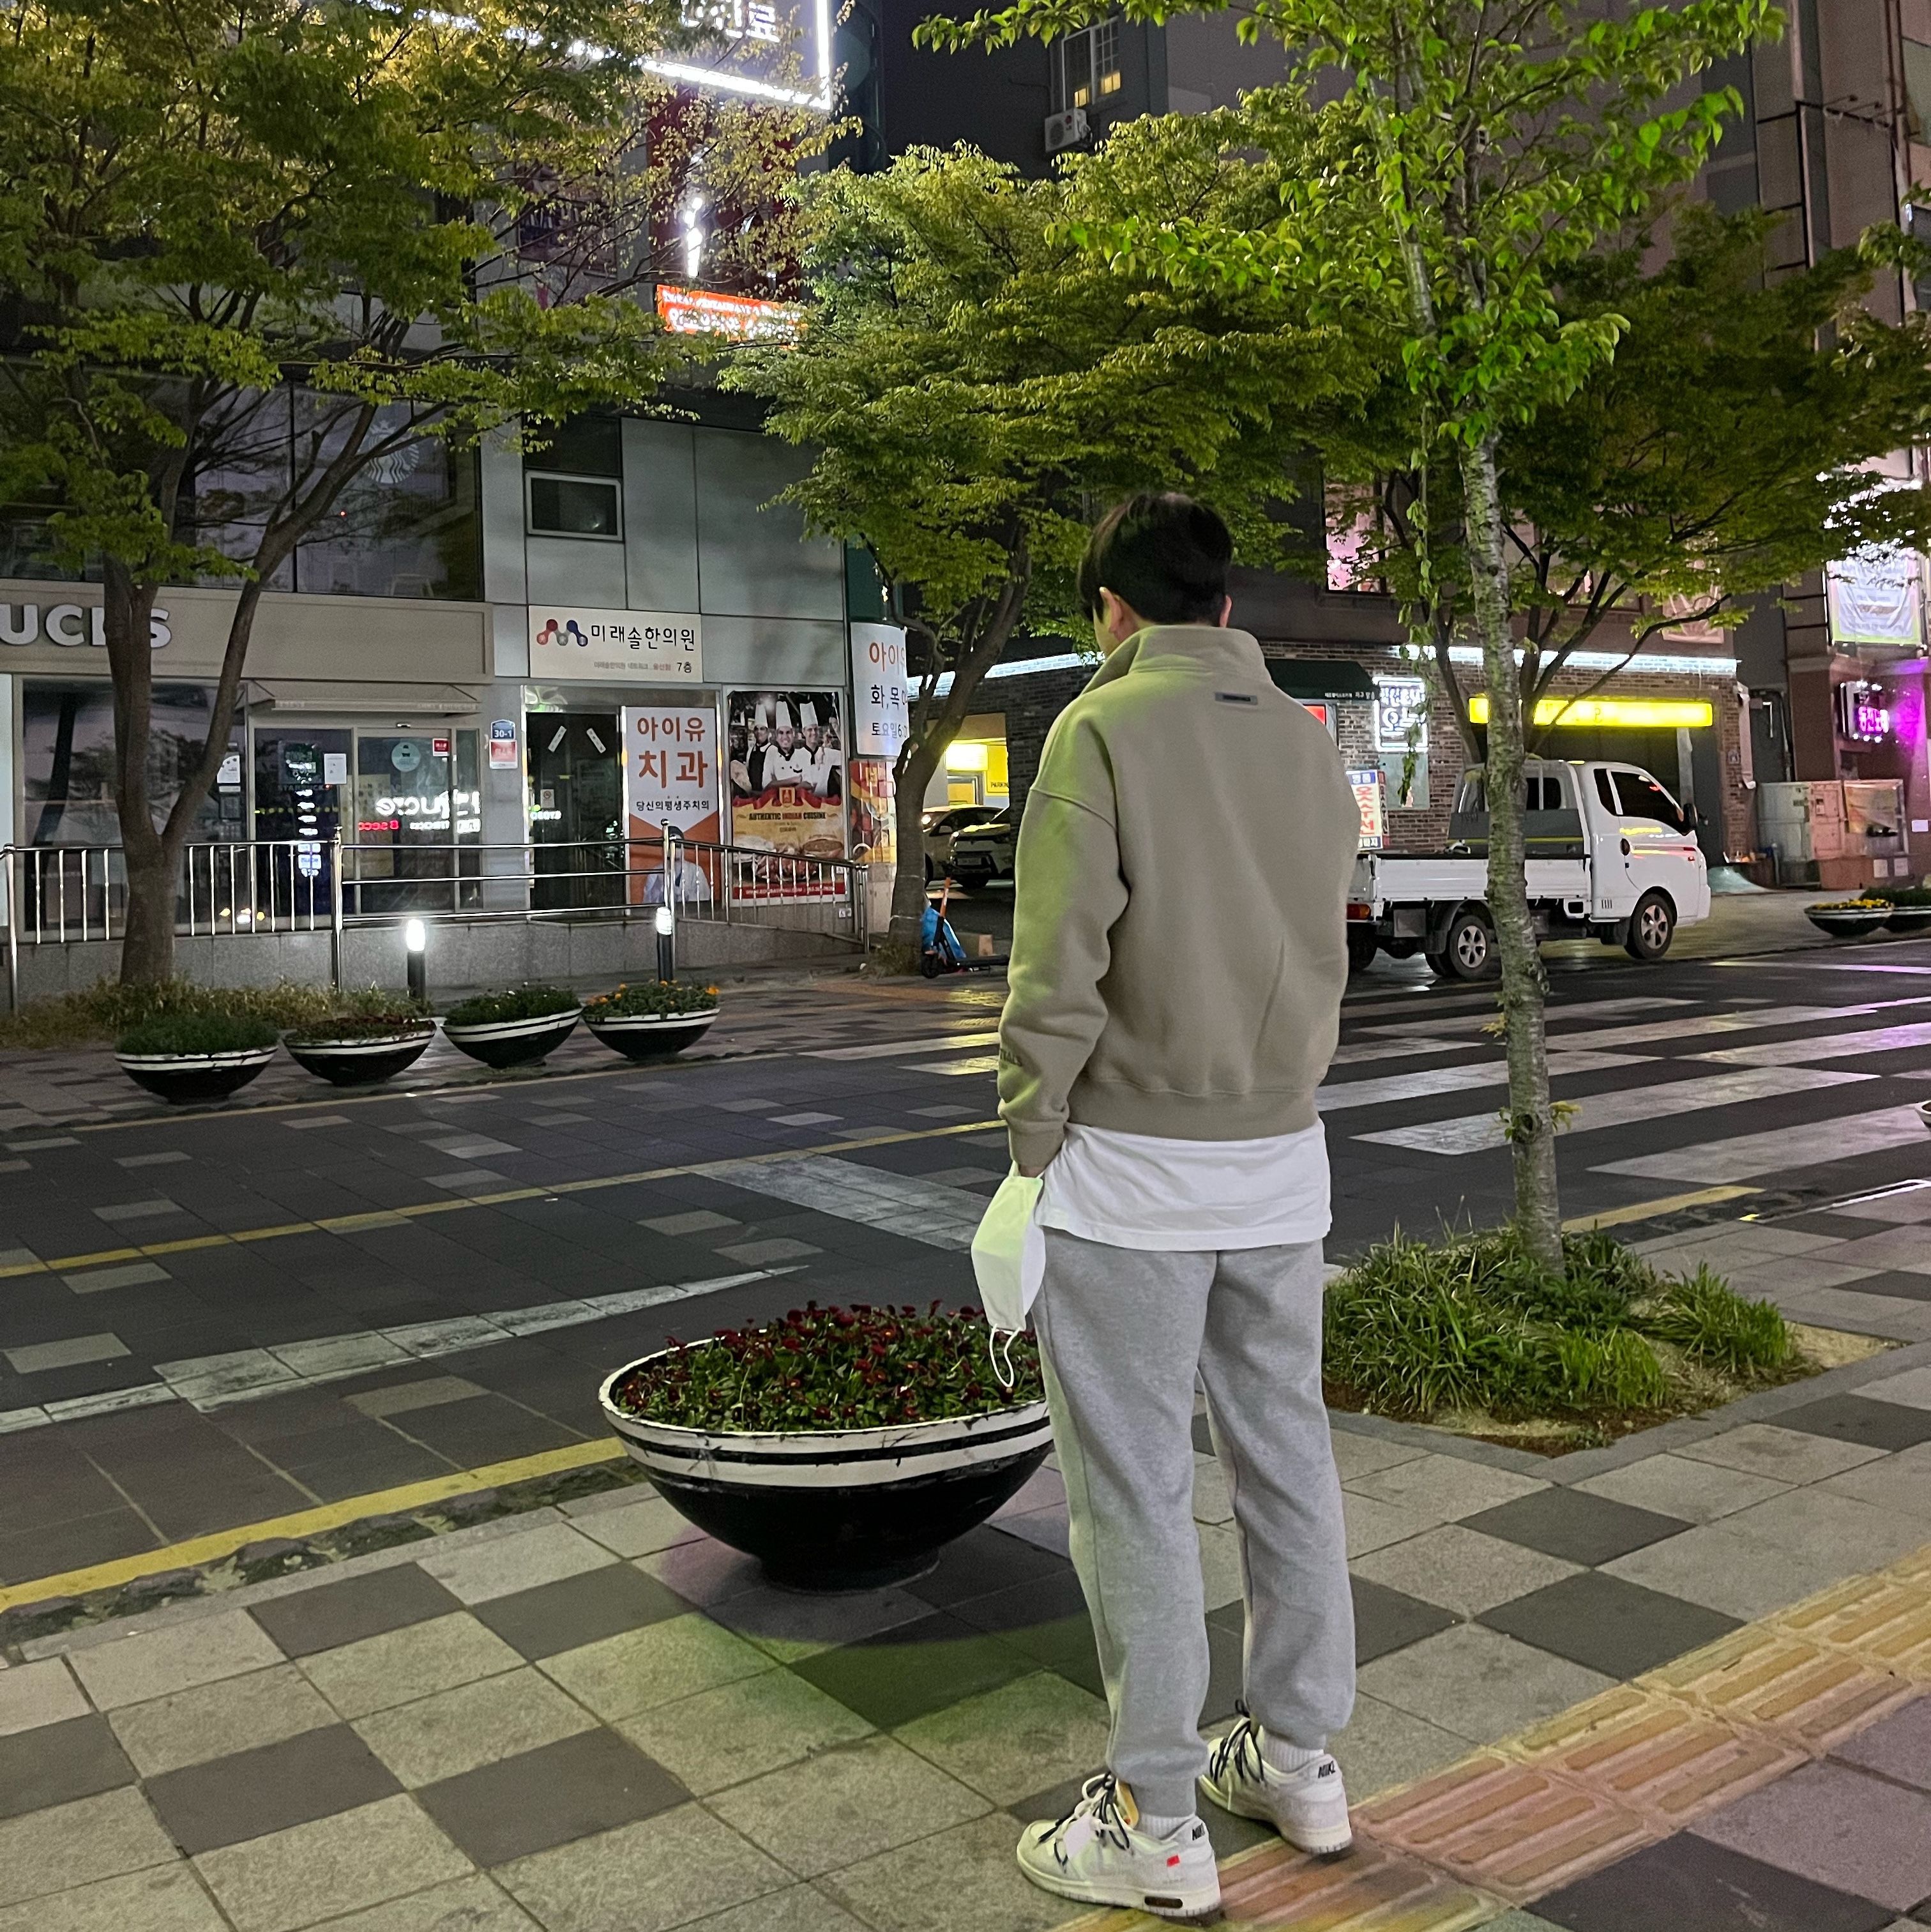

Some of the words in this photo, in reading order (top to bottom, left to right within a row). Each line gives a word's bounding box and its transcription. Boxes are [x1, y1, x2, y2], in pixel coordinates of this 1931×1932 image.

[591, 625, 695, 651] 미래솔한의원
[677, 661, 692, 674] 7층
[494, 729, 512, 738] 30-1
[637, 717, 706, 742] 아이유
[639, 750, 708, 789] 치과
[748, 812, 781, 821] AUTHENTIC
